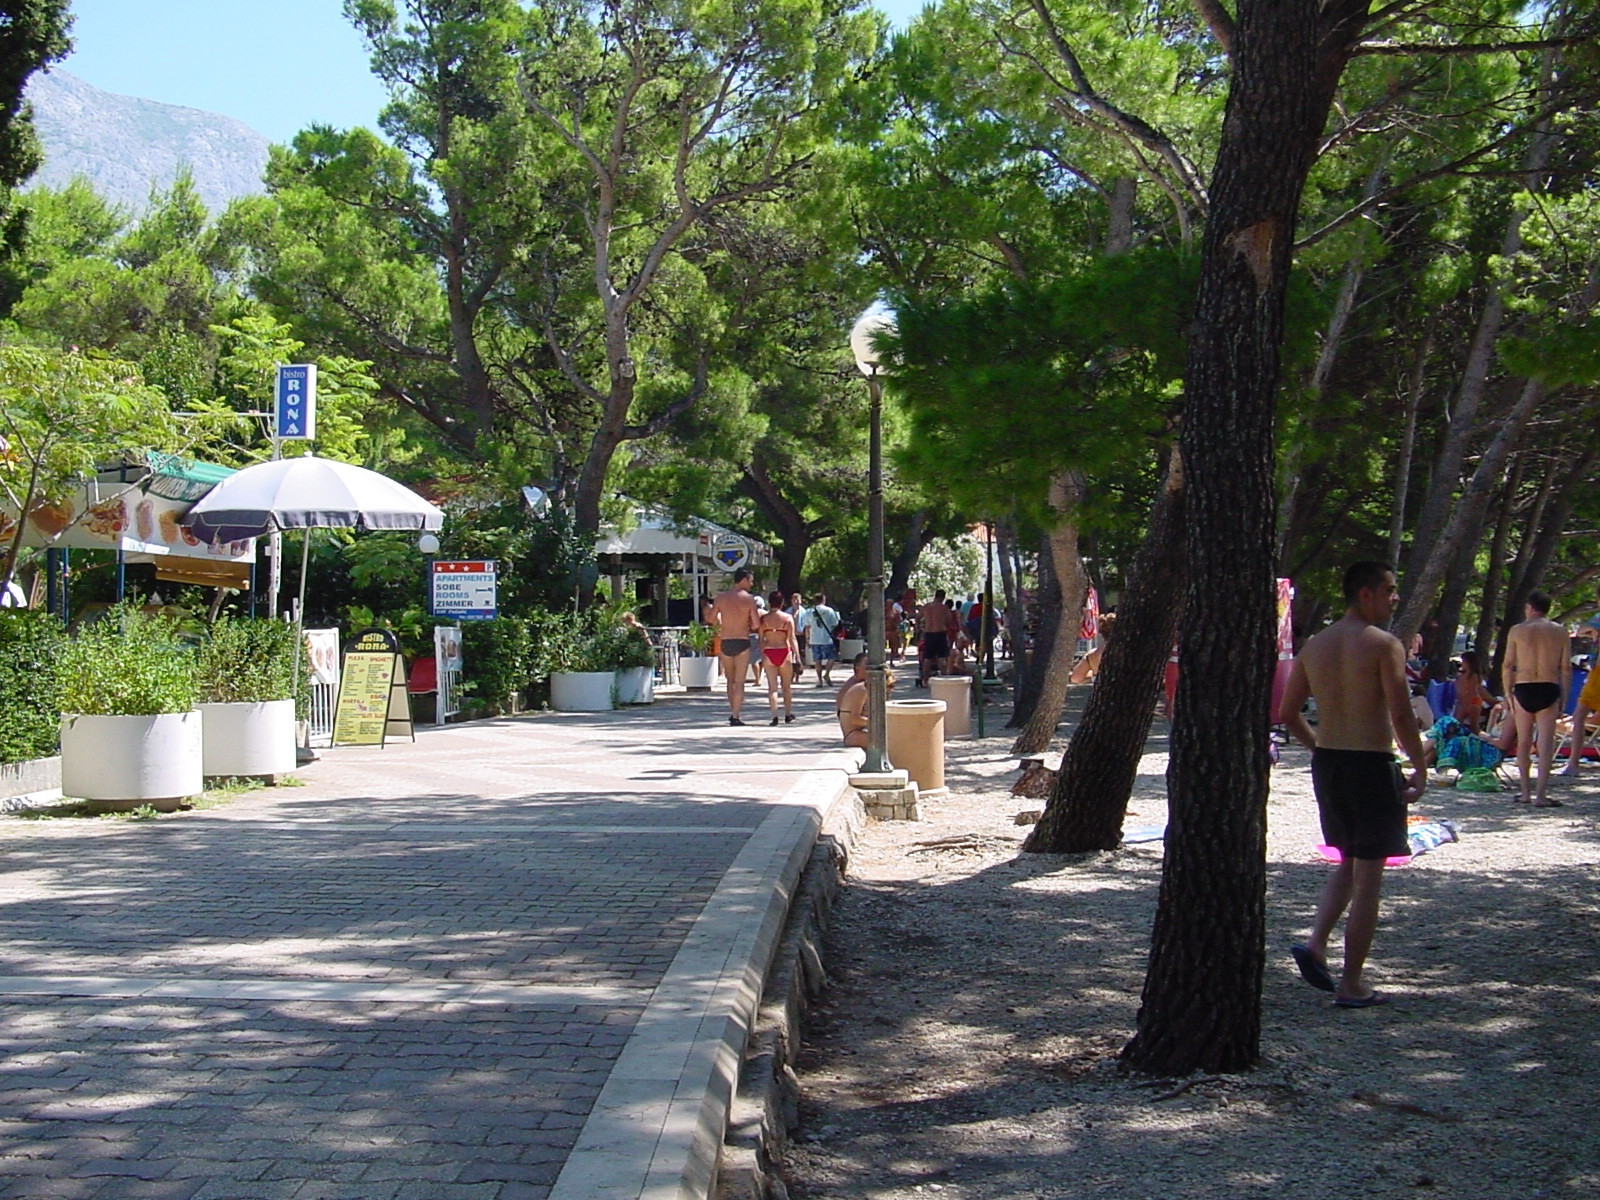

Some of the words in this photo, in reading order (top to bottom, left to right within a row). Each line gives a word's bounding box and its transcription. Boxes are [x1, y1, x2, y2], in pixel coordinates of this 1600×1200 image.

[283, 369, 305, 379] bistro
[286, 379, 300, 434] RONA
[436, 574, 493, 582] APARTMENTS
[436, 583, 462, 591] SOBE
[436, 591, 470, 599] ROOMS
